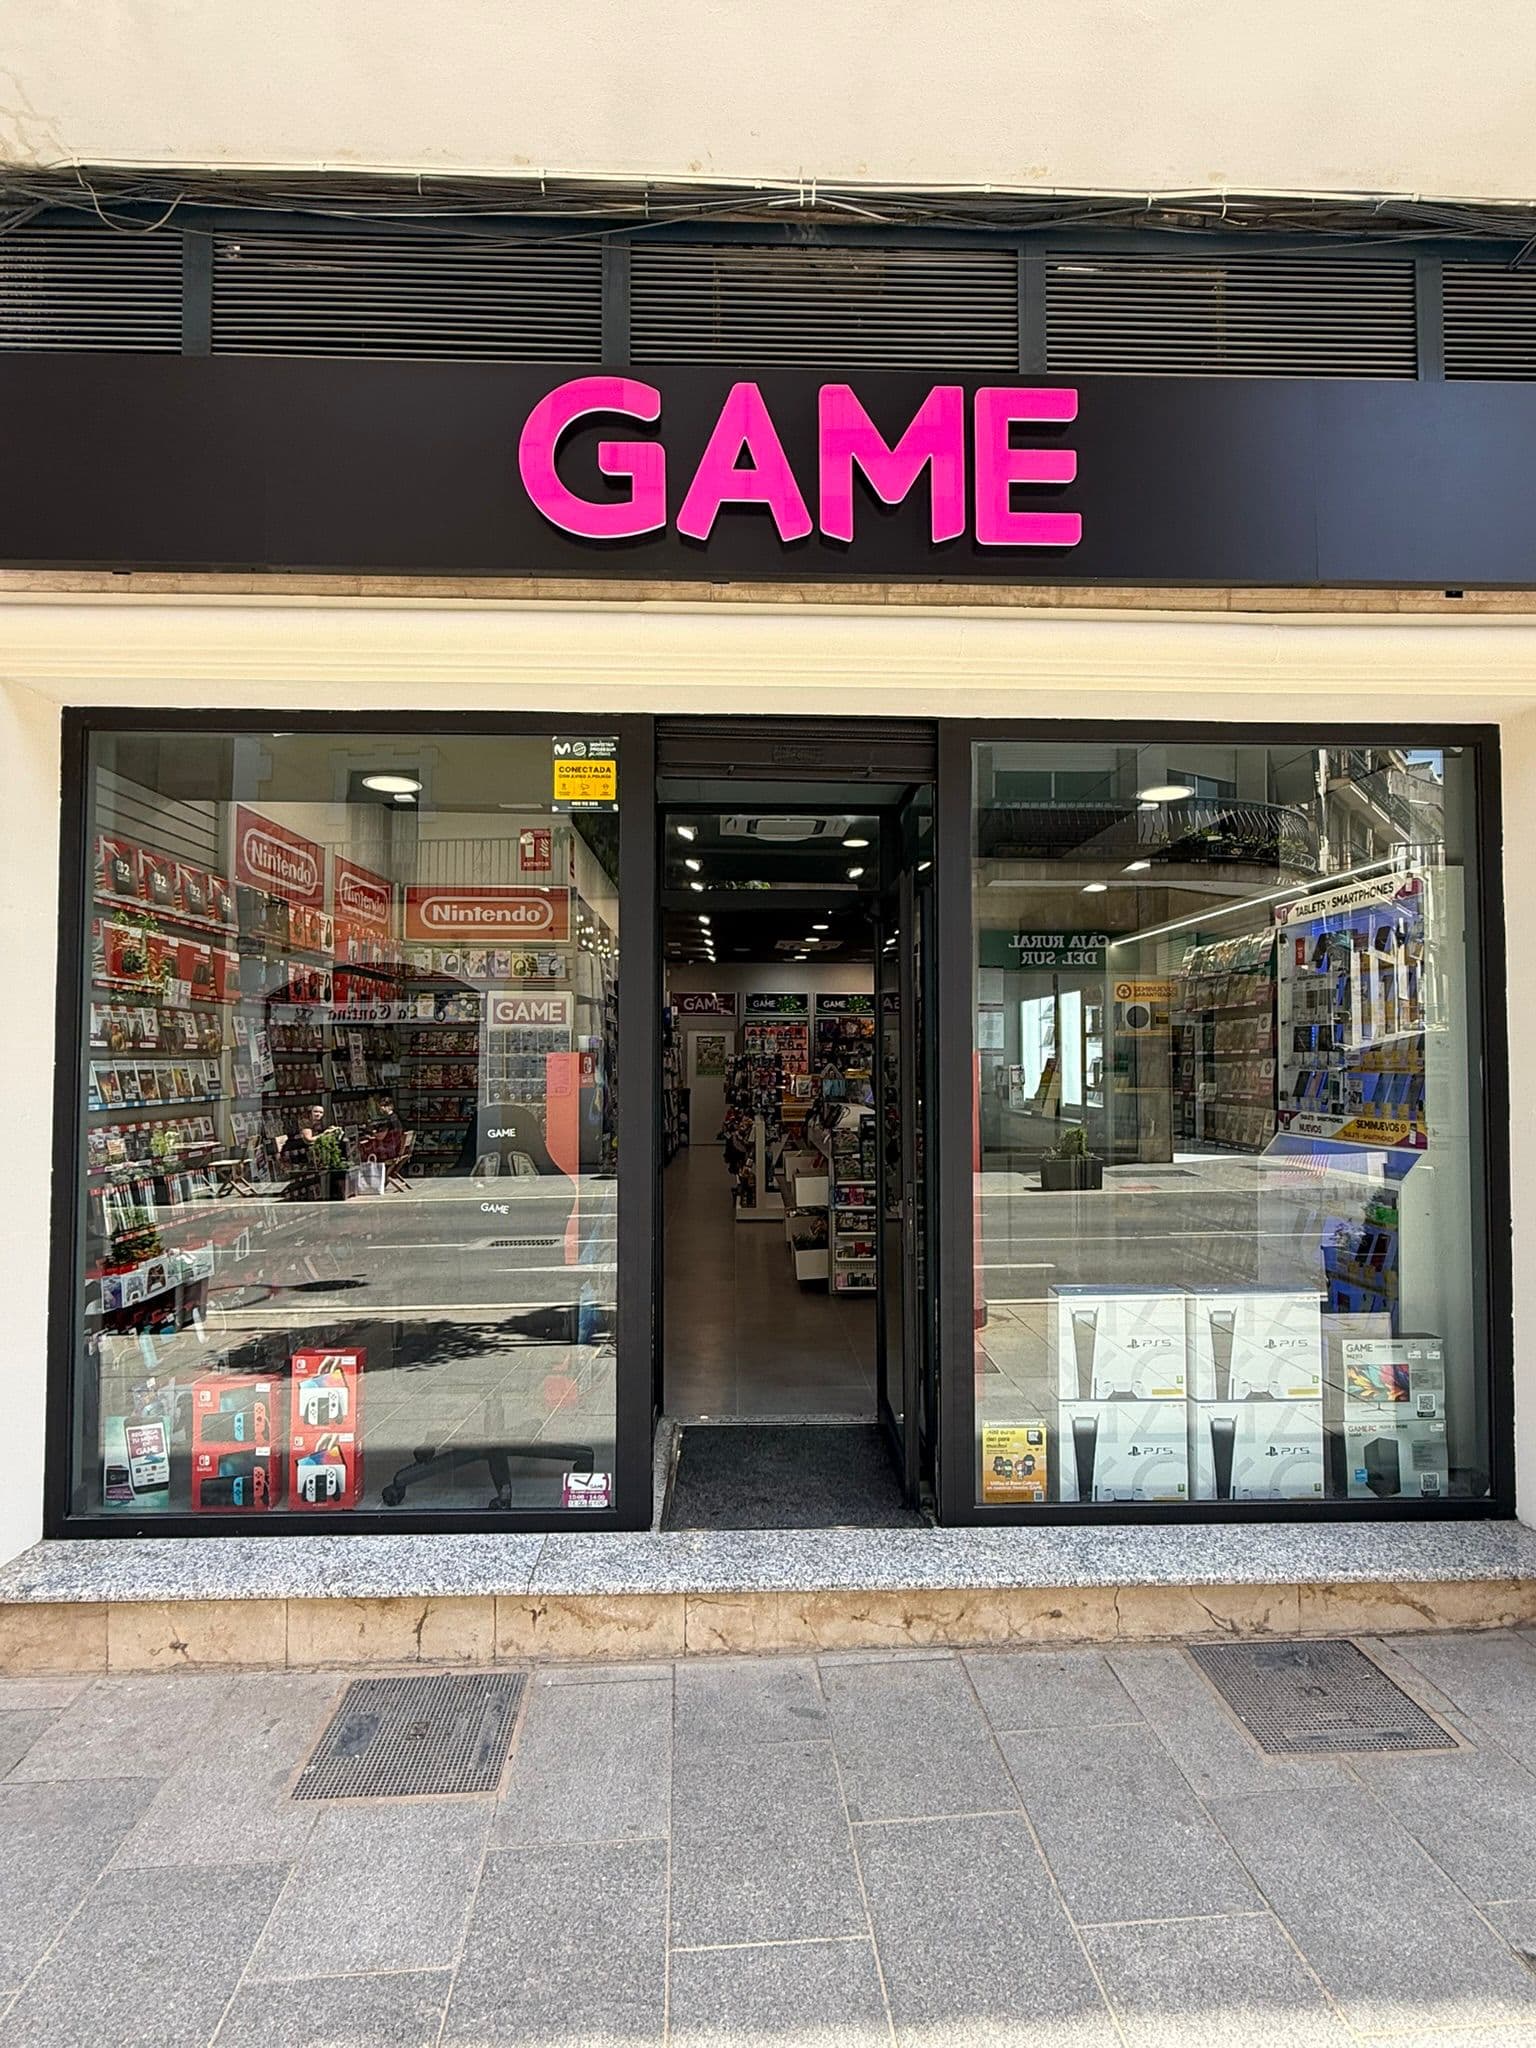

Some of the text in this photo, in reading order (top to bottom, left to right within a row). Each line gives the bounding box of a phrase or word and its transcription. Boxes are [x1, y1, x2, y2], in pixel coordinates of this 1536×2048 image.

[518, 376, 1083, 546] GAME
[251, 840, 311, 885] Nintendo
[1295, 900, 1326, 917] TABLETS
[1331, 881, 1395, 908] SMARTPHONES
[432, 904, 541, 922] Nintendo
[683, 997, 725, 1011] GAME
[752, 1000, 776, 1008] GAME
[823, 1000, 846, 1009] GAME
[496, 1002, 562, 1021] GAME
[147, 1018, 155, 1033] 2
[187, 1021, 195, 1036] 3
[1299, 1124, 1322, 1134] NUEVOS
[1356, 1120, 1400, 1133] SEMINUEVOS
[487, 1128, 516, 1138] GAME
[480, 1202, 510, 1215] GAME
[1142, 1339, 1172, 1348] PS5
[1279, 1339, 1309, 1348] PS5
[1345, 1343, 1374, 1353] GAME
[135, 1446, 159, 1455] GAME
[1143, 1447, 1174, 1456] PS5
[1280, 1447, 1310, 1456] PS5
